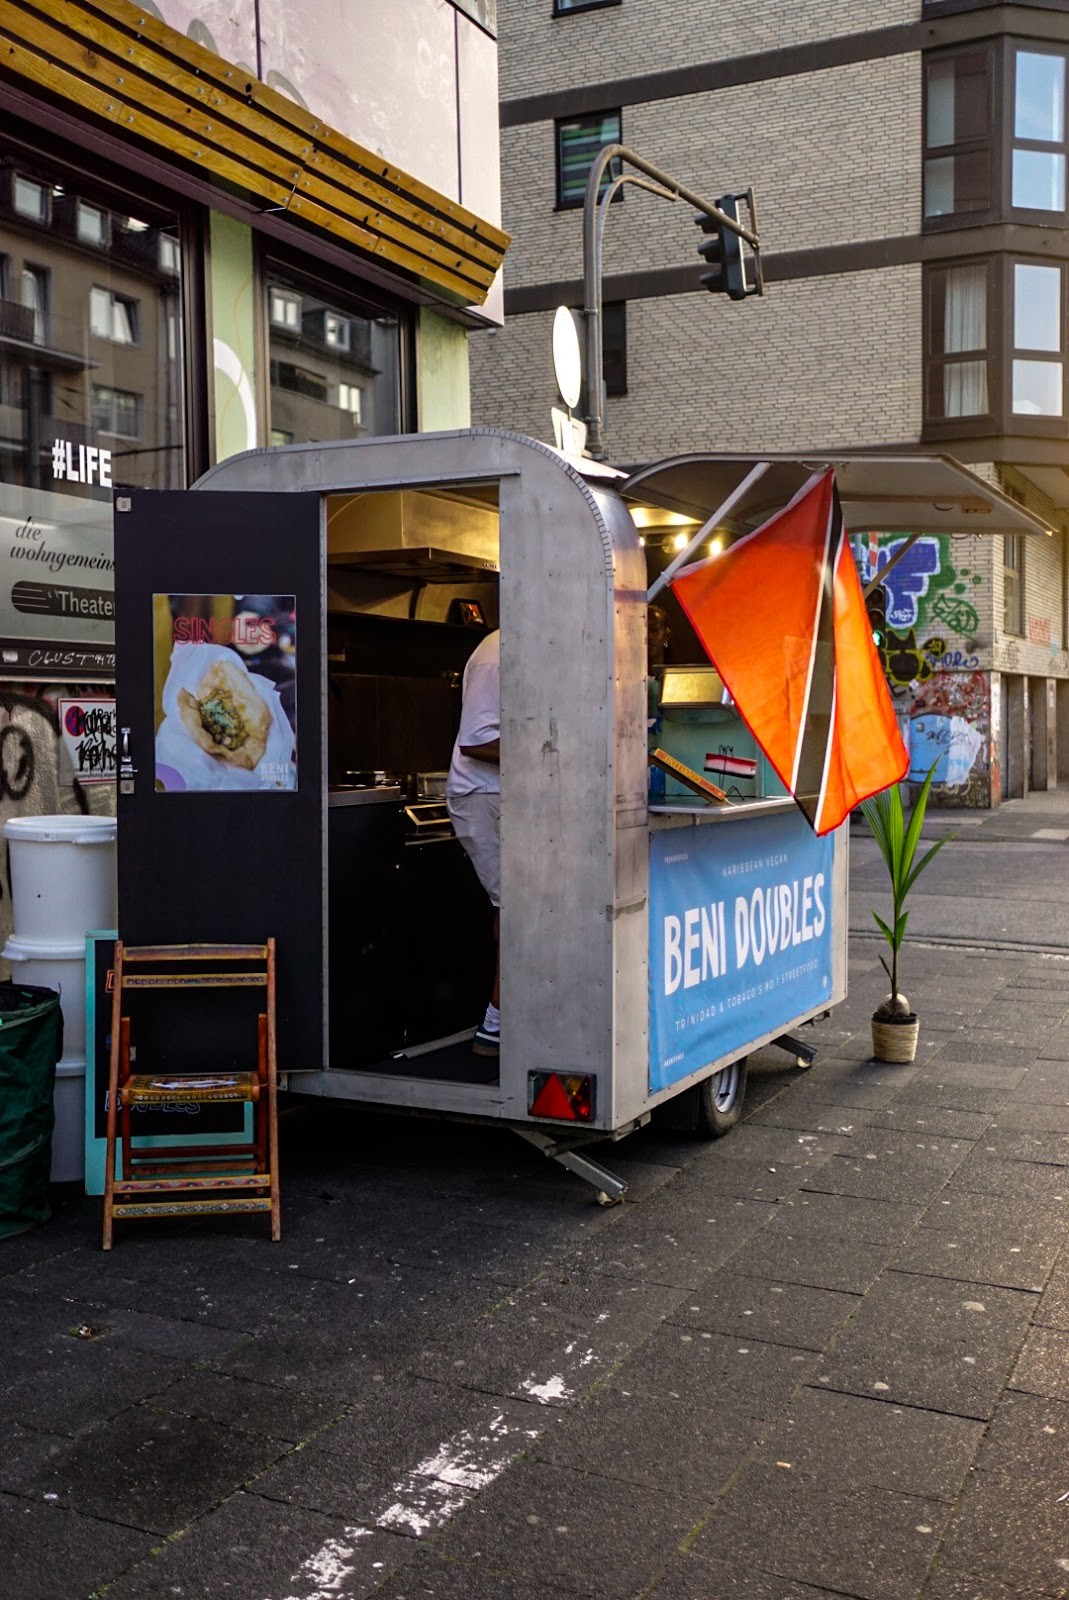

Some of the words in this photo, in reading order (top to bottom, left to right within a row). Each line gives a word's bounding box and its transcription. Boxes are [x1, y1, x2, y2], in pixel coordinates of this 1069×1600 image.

[52, 438, 113, 488] #LIFE
[15, 516, 41, 541] die
[261, 763, 289, 775] BENI
[722, 859, 763, 877] KARIBBEAN
[766, 853, 788, 867] VEGAN
[664, 901, 728, 996] BENI
[734, 872, 827, 970] DOUBLES
[675, 1004, 717, 1032] TRINIDAD
[719, 1002, 725, 1013] &
[727, 983, 763, 1007] TOBAGO'S
[781, 959, 819, 984] STREETFOOD
